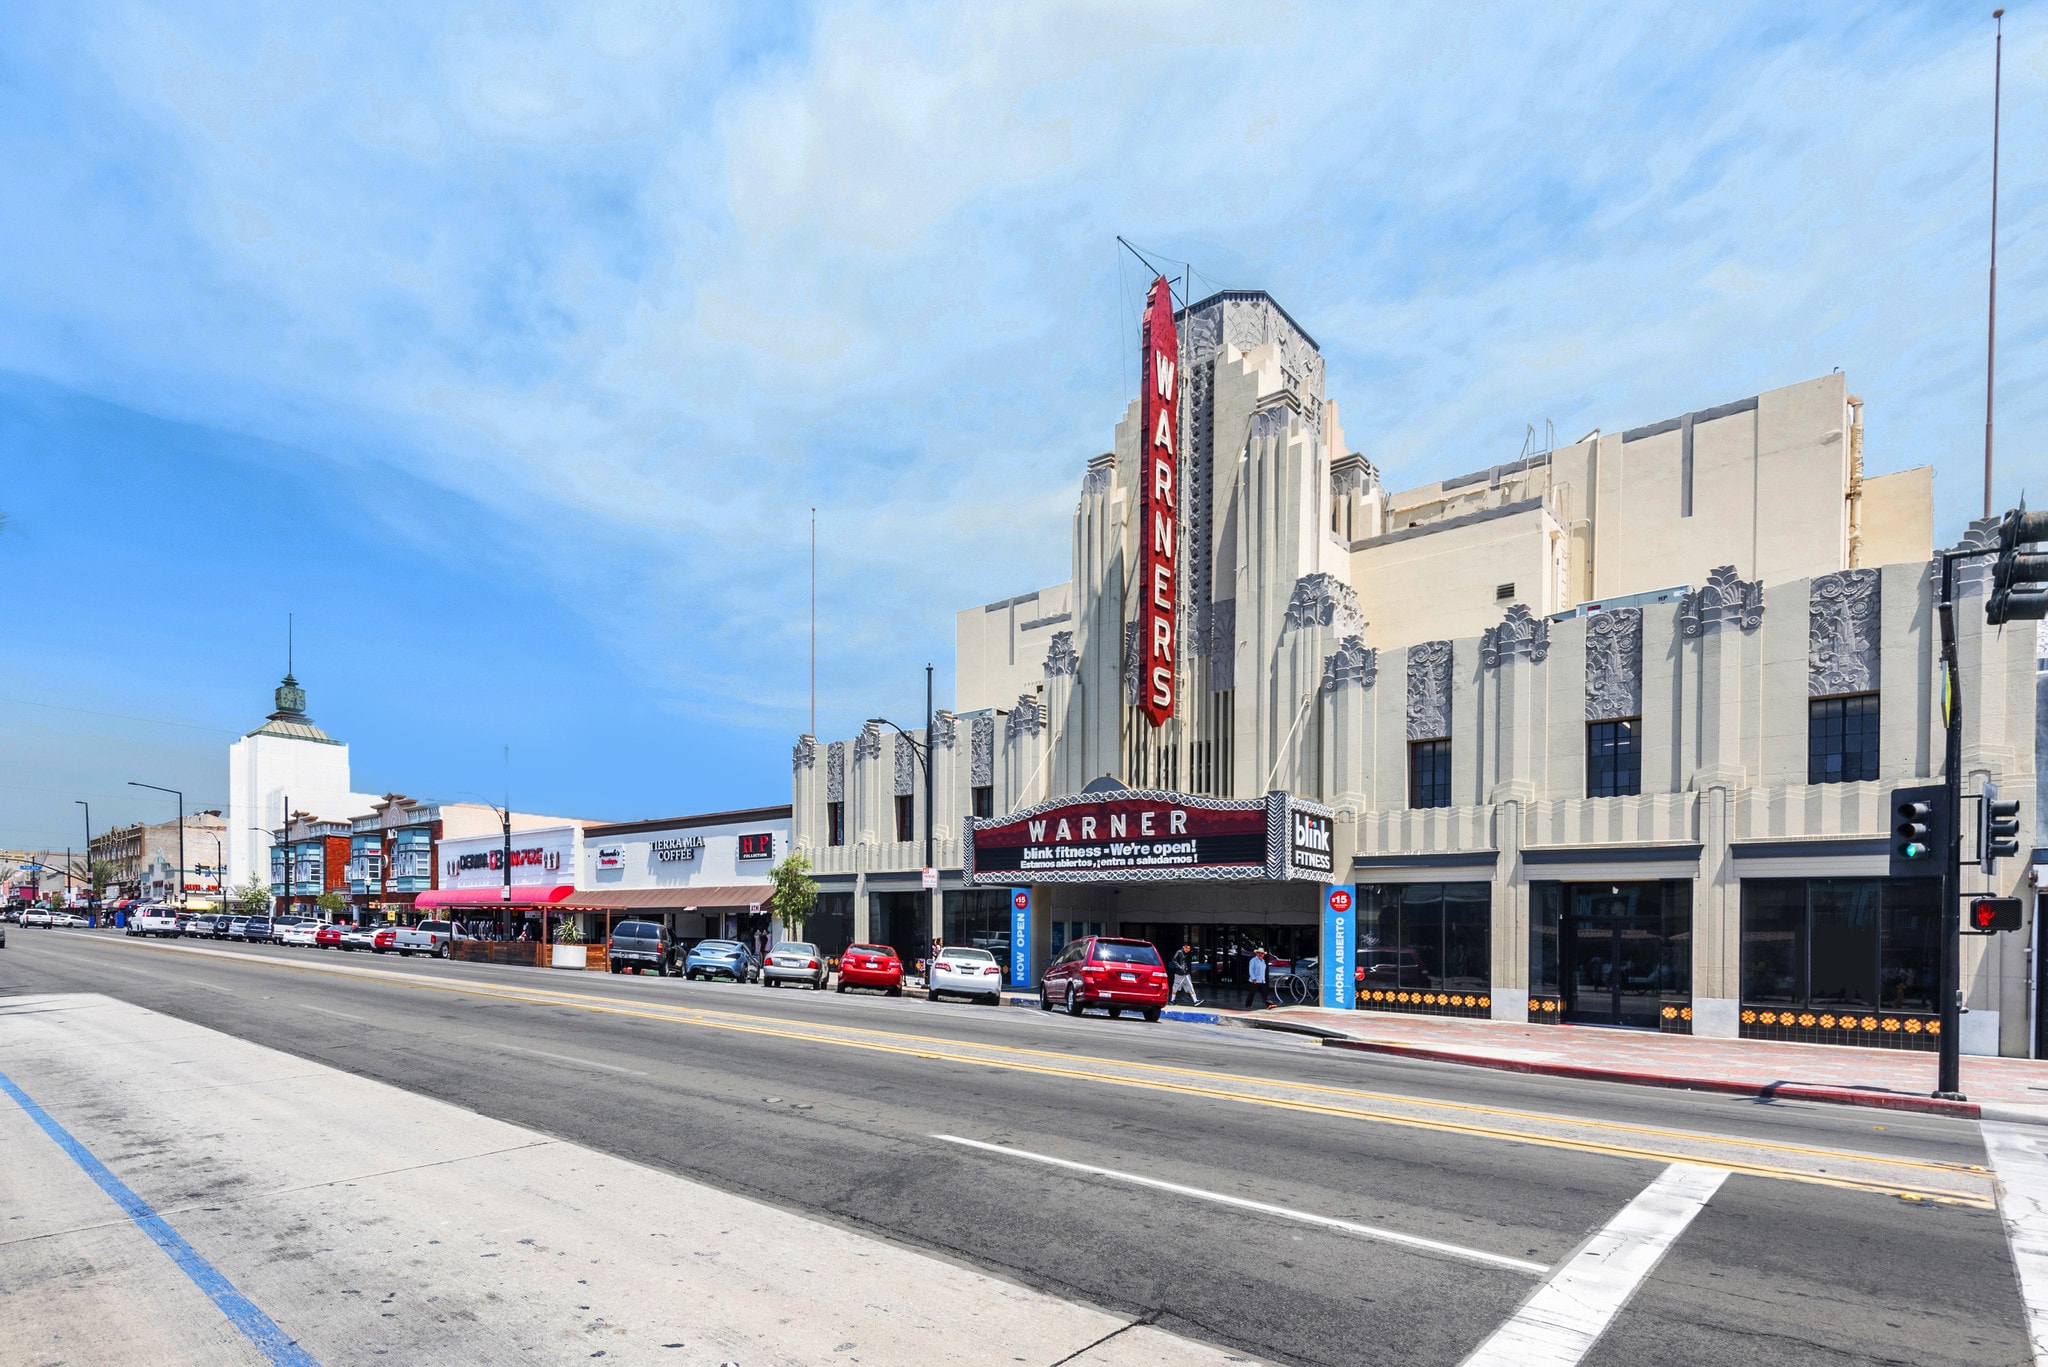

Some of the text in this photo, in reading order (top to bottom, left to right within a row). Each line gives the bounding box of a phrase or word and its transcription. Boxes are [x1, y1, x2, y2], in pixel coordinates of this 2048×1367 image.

[1153, 349, 1175, 707] WARNERS
[1028, 810, 1188, 843] WARNER
[1295, 813, 1330, 851] blink
[648, 836, 704, 851] TIERRA MIA
[658, 849, 694, 861] COFFEE
[1023, 847, 1053, 860] blink
[1055, 846, 1101, 859] fitness
[1153, 840, 1197, 856] open!
[1020, 860, 1056, 869] Estamos
[1295, 850, 1331, 869] FITNESS
[1016, 913, 1025, 947] OPEN
[1335, 917, 1345, 964] ABIERTO
[1016, 952, 1025, 981] NOW
[1335, 965, 1345, 1004] AHORA
